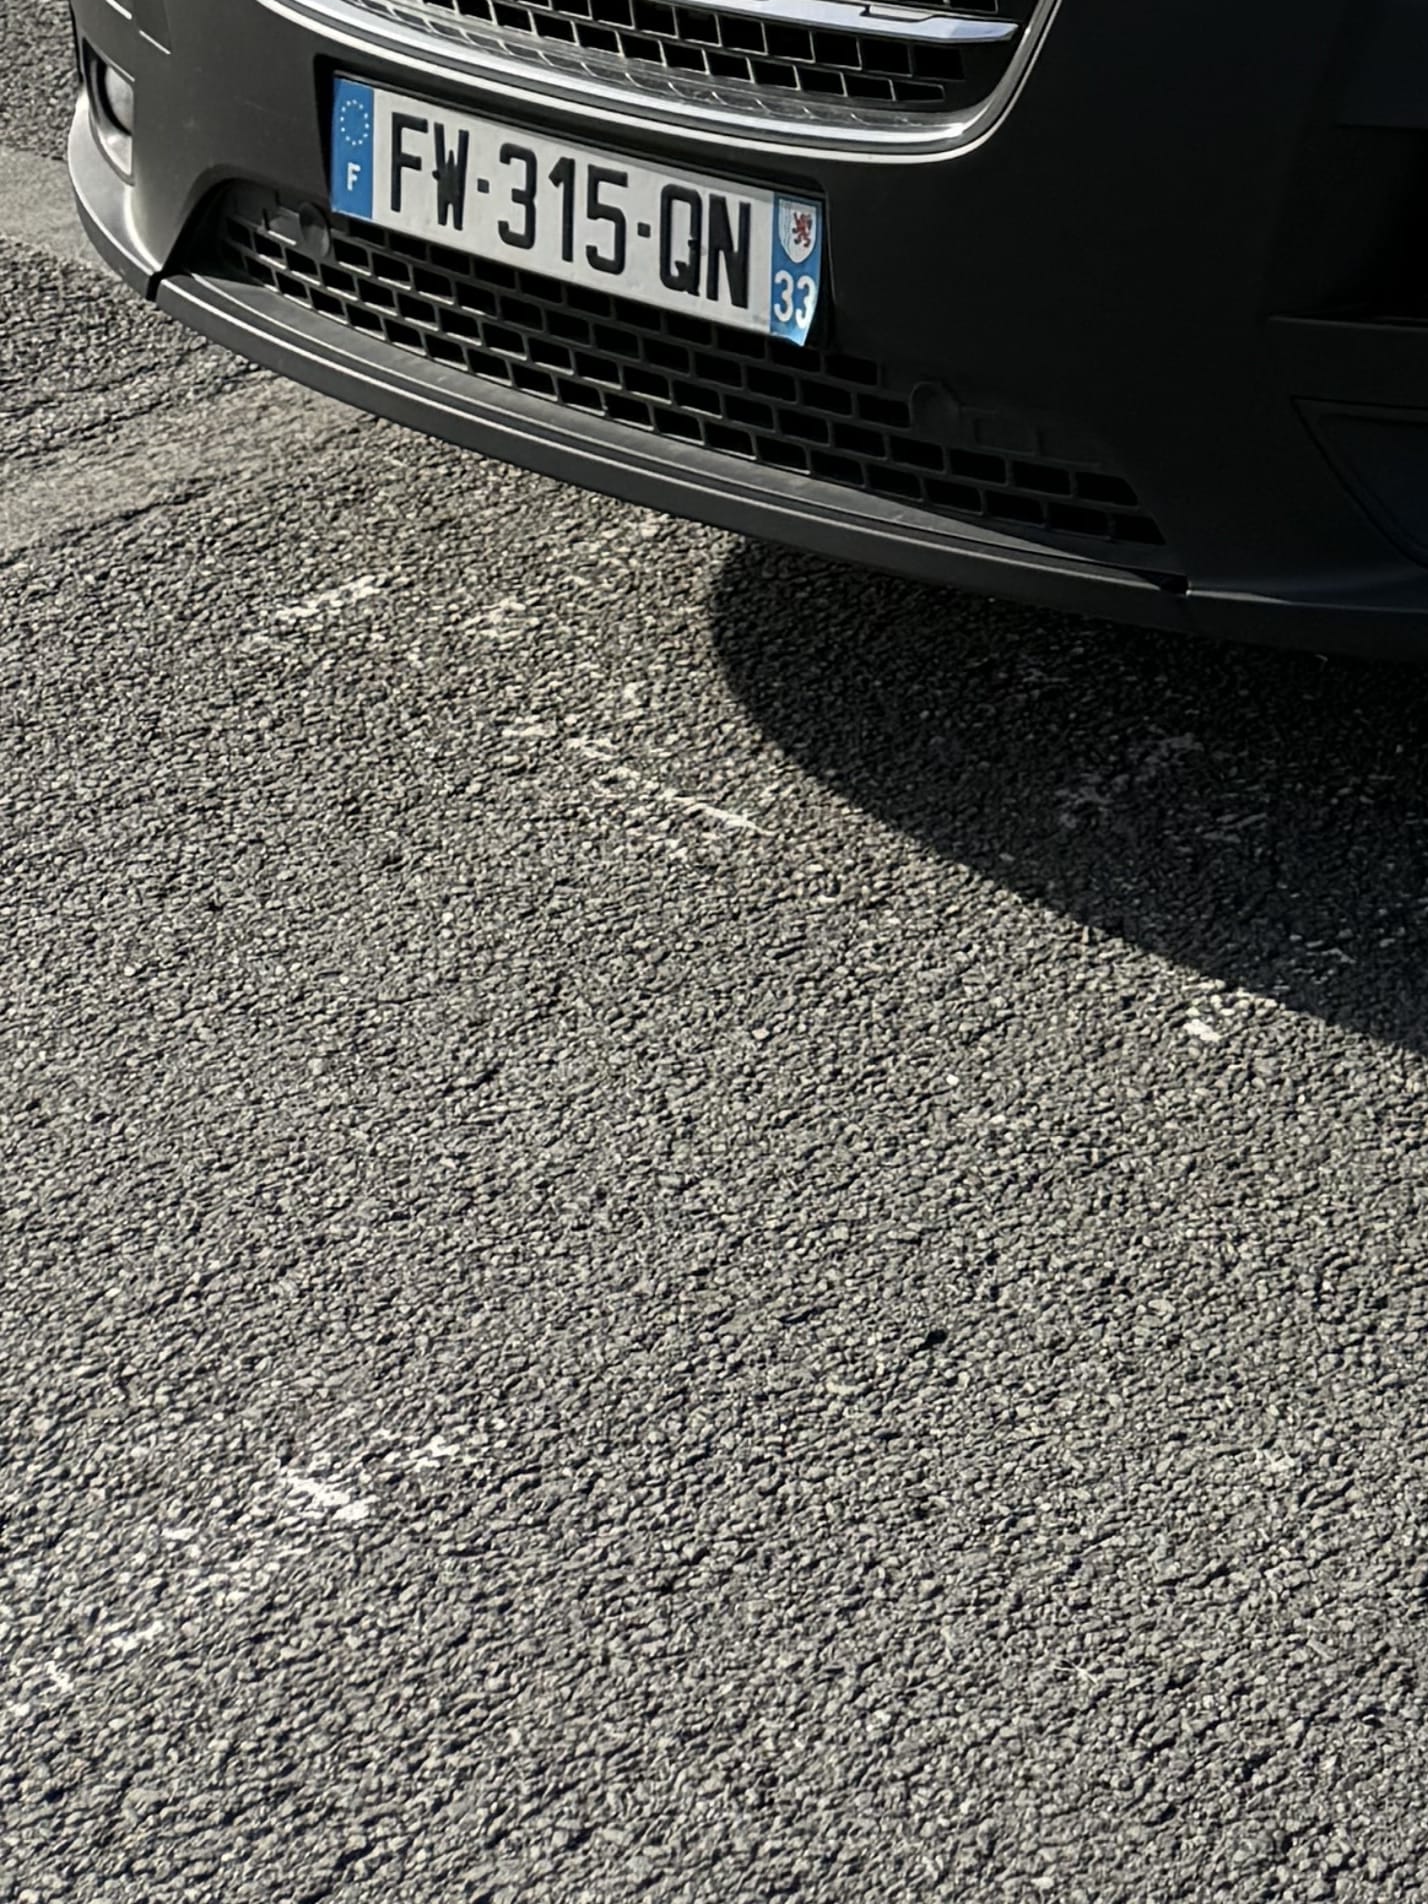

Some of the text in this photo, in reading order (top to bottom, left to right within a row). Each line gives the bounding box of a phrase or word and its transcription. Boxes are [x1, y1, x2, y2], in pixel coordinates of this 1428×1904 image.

[346, 111, 817, 330] F FW-315-QN 33
